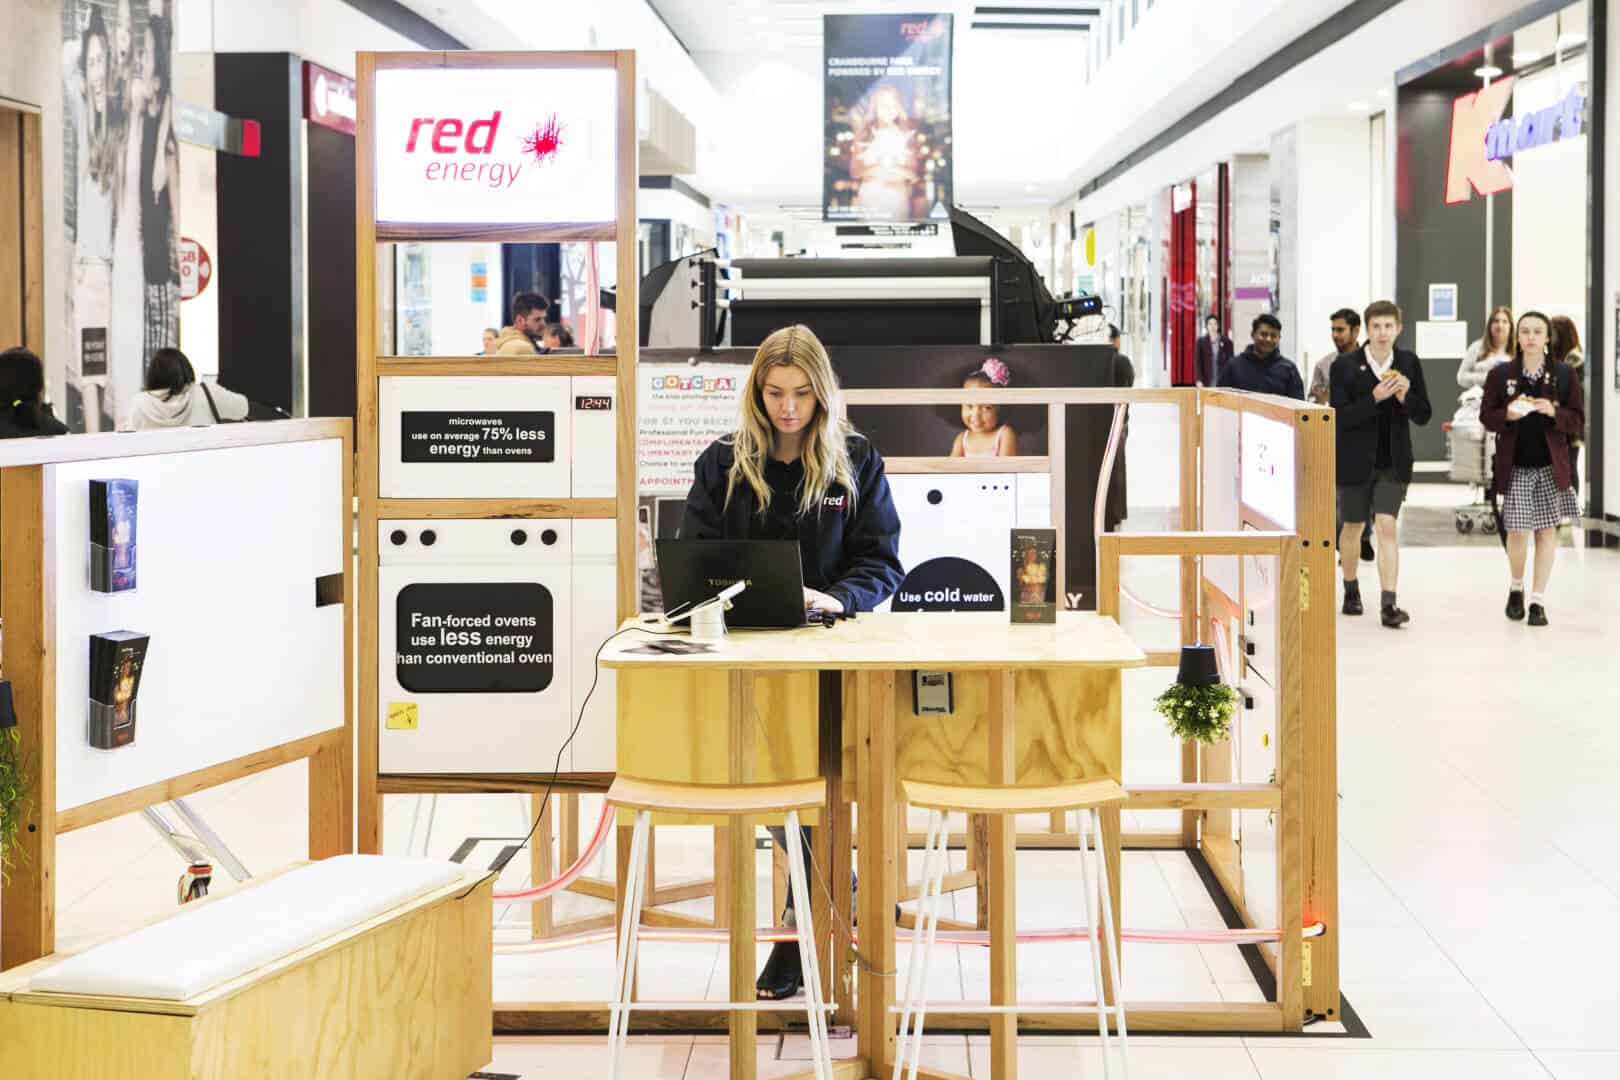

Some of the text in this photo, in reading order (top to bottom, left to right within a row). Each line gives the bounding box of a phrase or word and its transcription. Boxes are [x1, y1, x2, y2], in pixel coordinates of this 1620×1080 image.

[405, 110, 502, 155] red
[425, 161, 523, 188] energy
[579, 398, 610, 409] 12:44
[448, 416, 503, 425] microwaves
[411, 427, 546, 442] use on average 75% less
[429, 444, 532, 458] energy than ovens
[823, 495, 845, 506] red
[899, 588, 995, 602] Use cold water
[411, 612, 537, 628] Fan-forced ovens
[410, 628, 534, 648] use less energy
[425, 651, 515, 665] conventional
